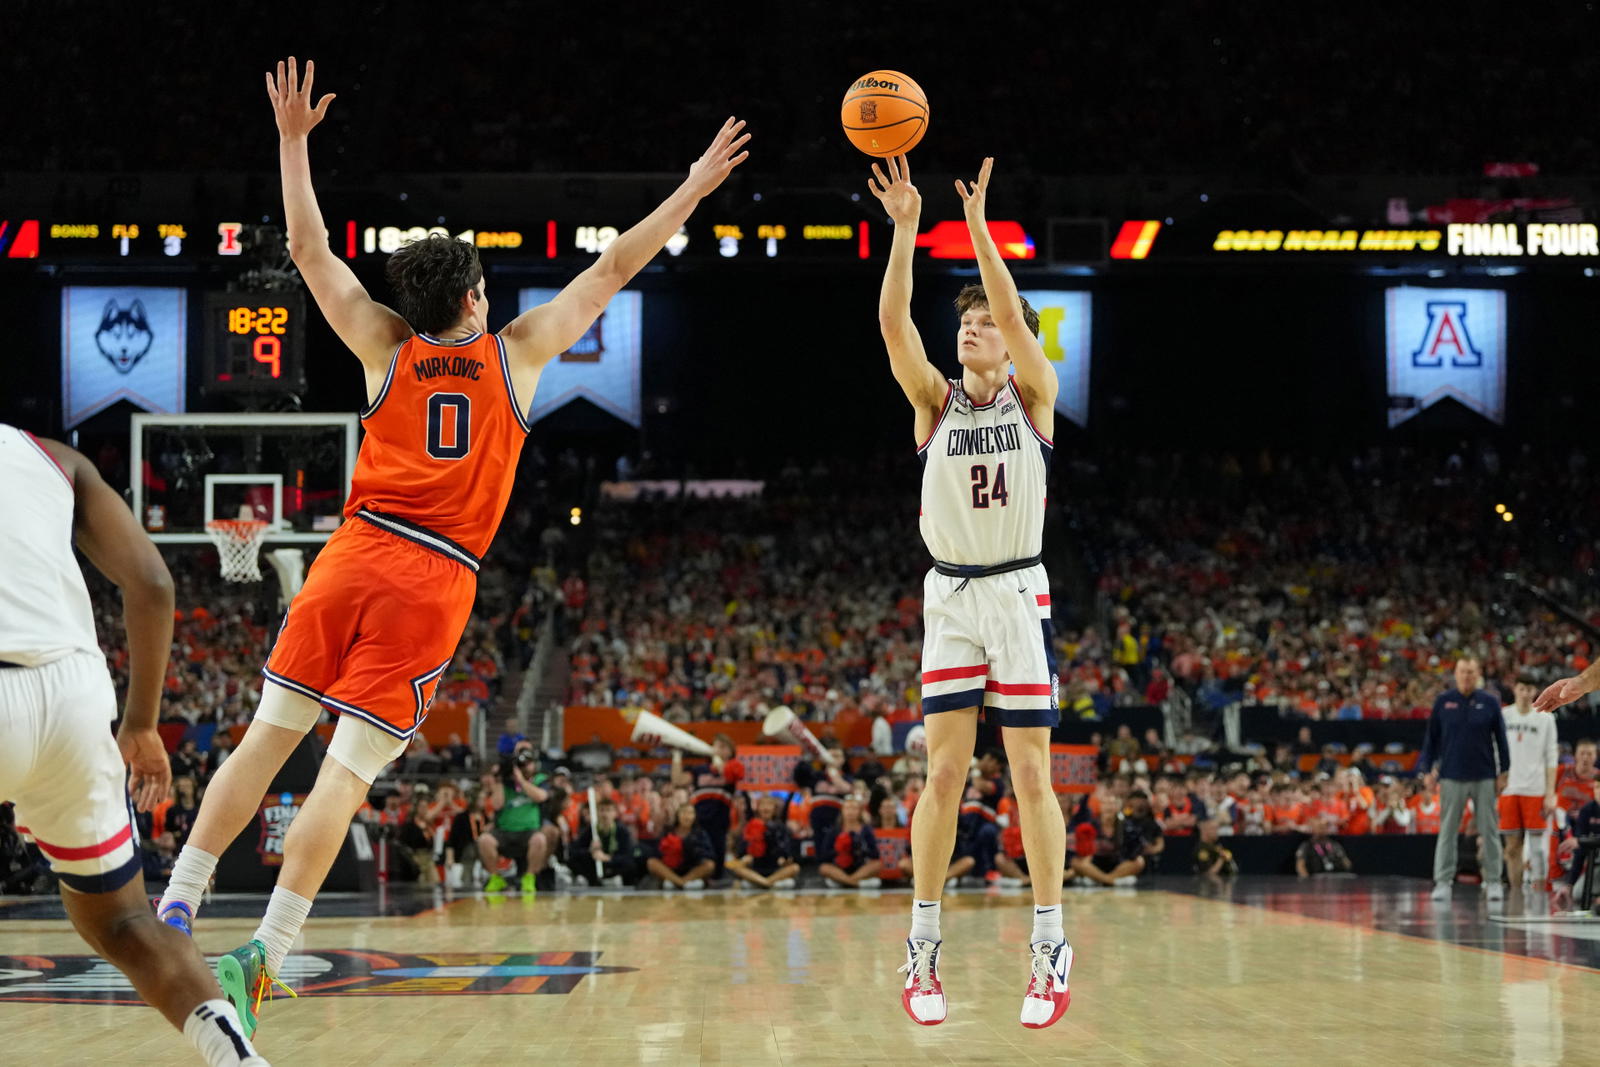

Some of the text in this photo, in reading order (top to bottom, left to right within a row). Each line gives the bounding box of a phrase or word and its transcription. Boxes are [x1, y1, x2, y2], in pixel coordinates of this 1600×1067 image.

[1447, 223, 1523, 255] FINAL
[1527, 223, 1599, 255] FOUR
[229, 307, 288, 334] 18:22
[1412, 302, 1481, 366] A
[253, 336, 281, 378] 9
[413, 356, 484, 381] MIRKOVIC
[426, 392, 471, 460] 0
[970, 463, 1008, 508] 24
